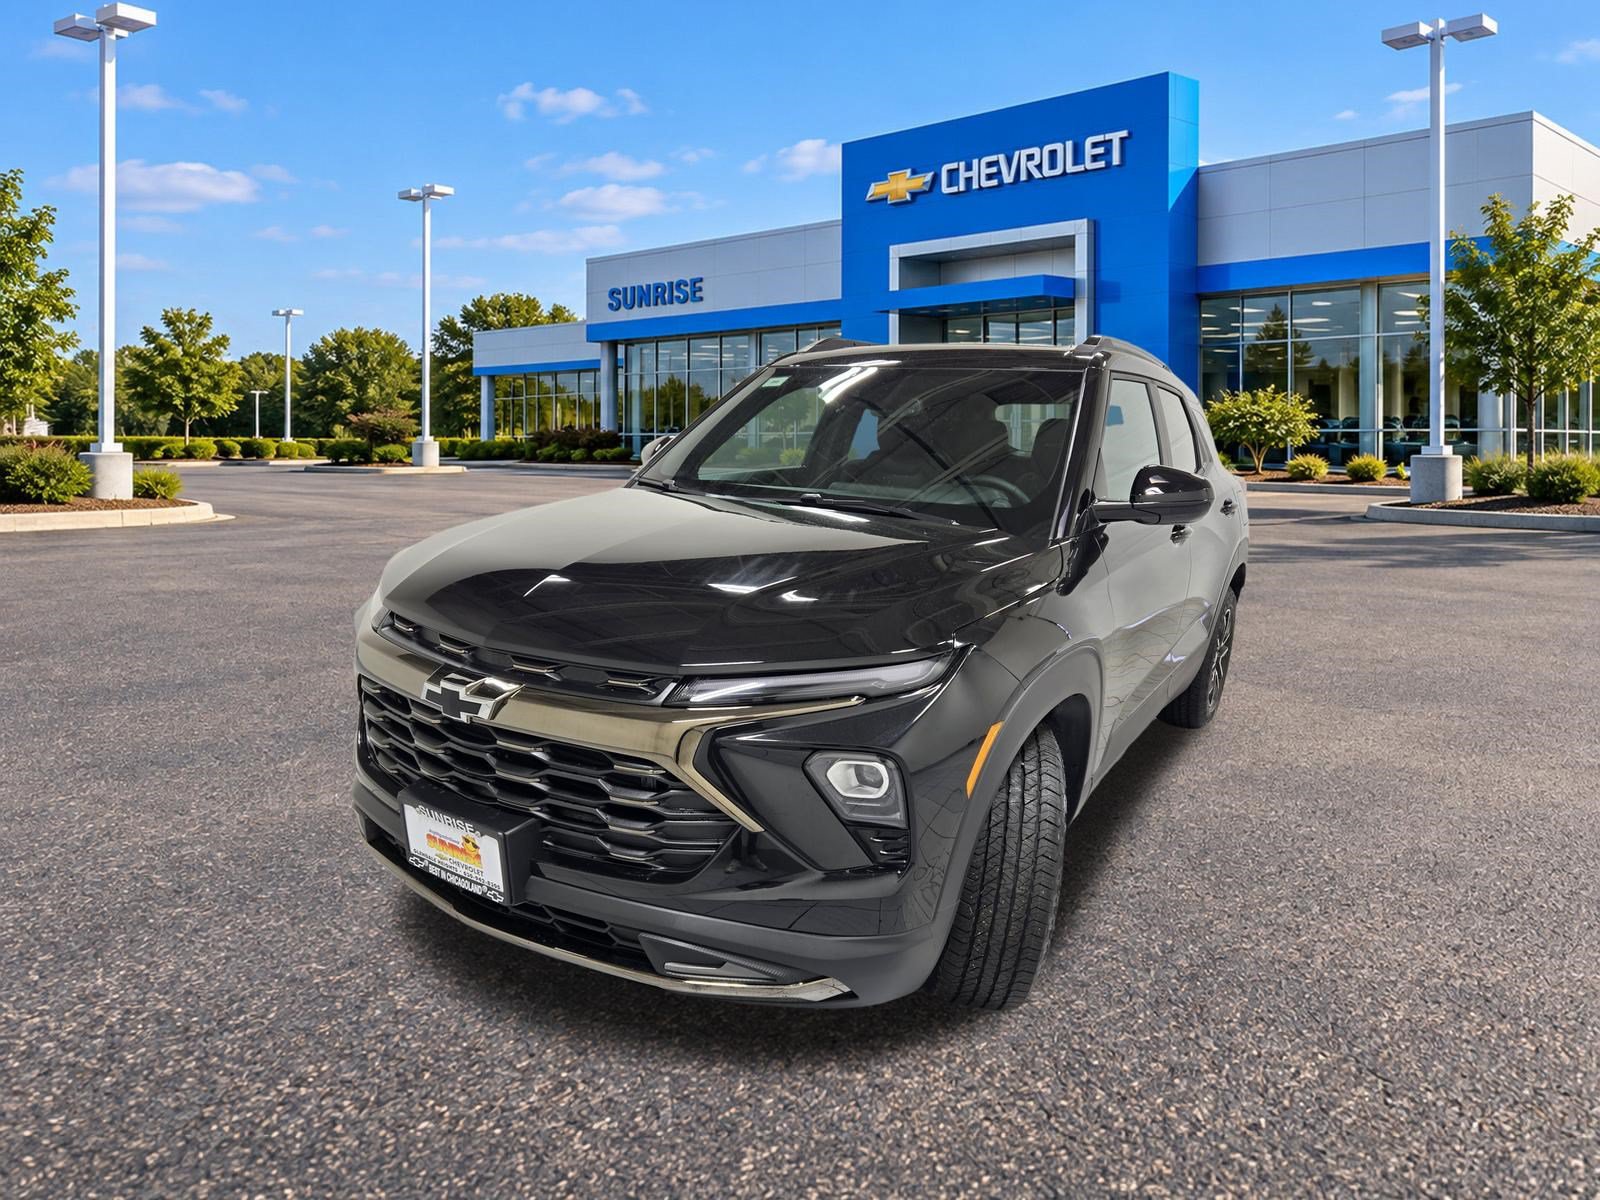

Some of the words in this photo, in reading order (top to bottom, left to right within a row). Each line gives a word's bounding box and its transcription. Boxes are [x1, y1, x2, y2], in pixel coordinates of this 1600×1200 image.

[941, 129, 1129, 194] CHEVROLET
[607, 277, 704, 312] SUNRISE
[418, 805, 474, 834] SUNRISE
[428, 864, 441, 878] BEST
[440, 869, 447, 880] IN
[446, 872, 483, 895] CHICAGOLAND
[448, 857, 484, 877] CHEVROLET
